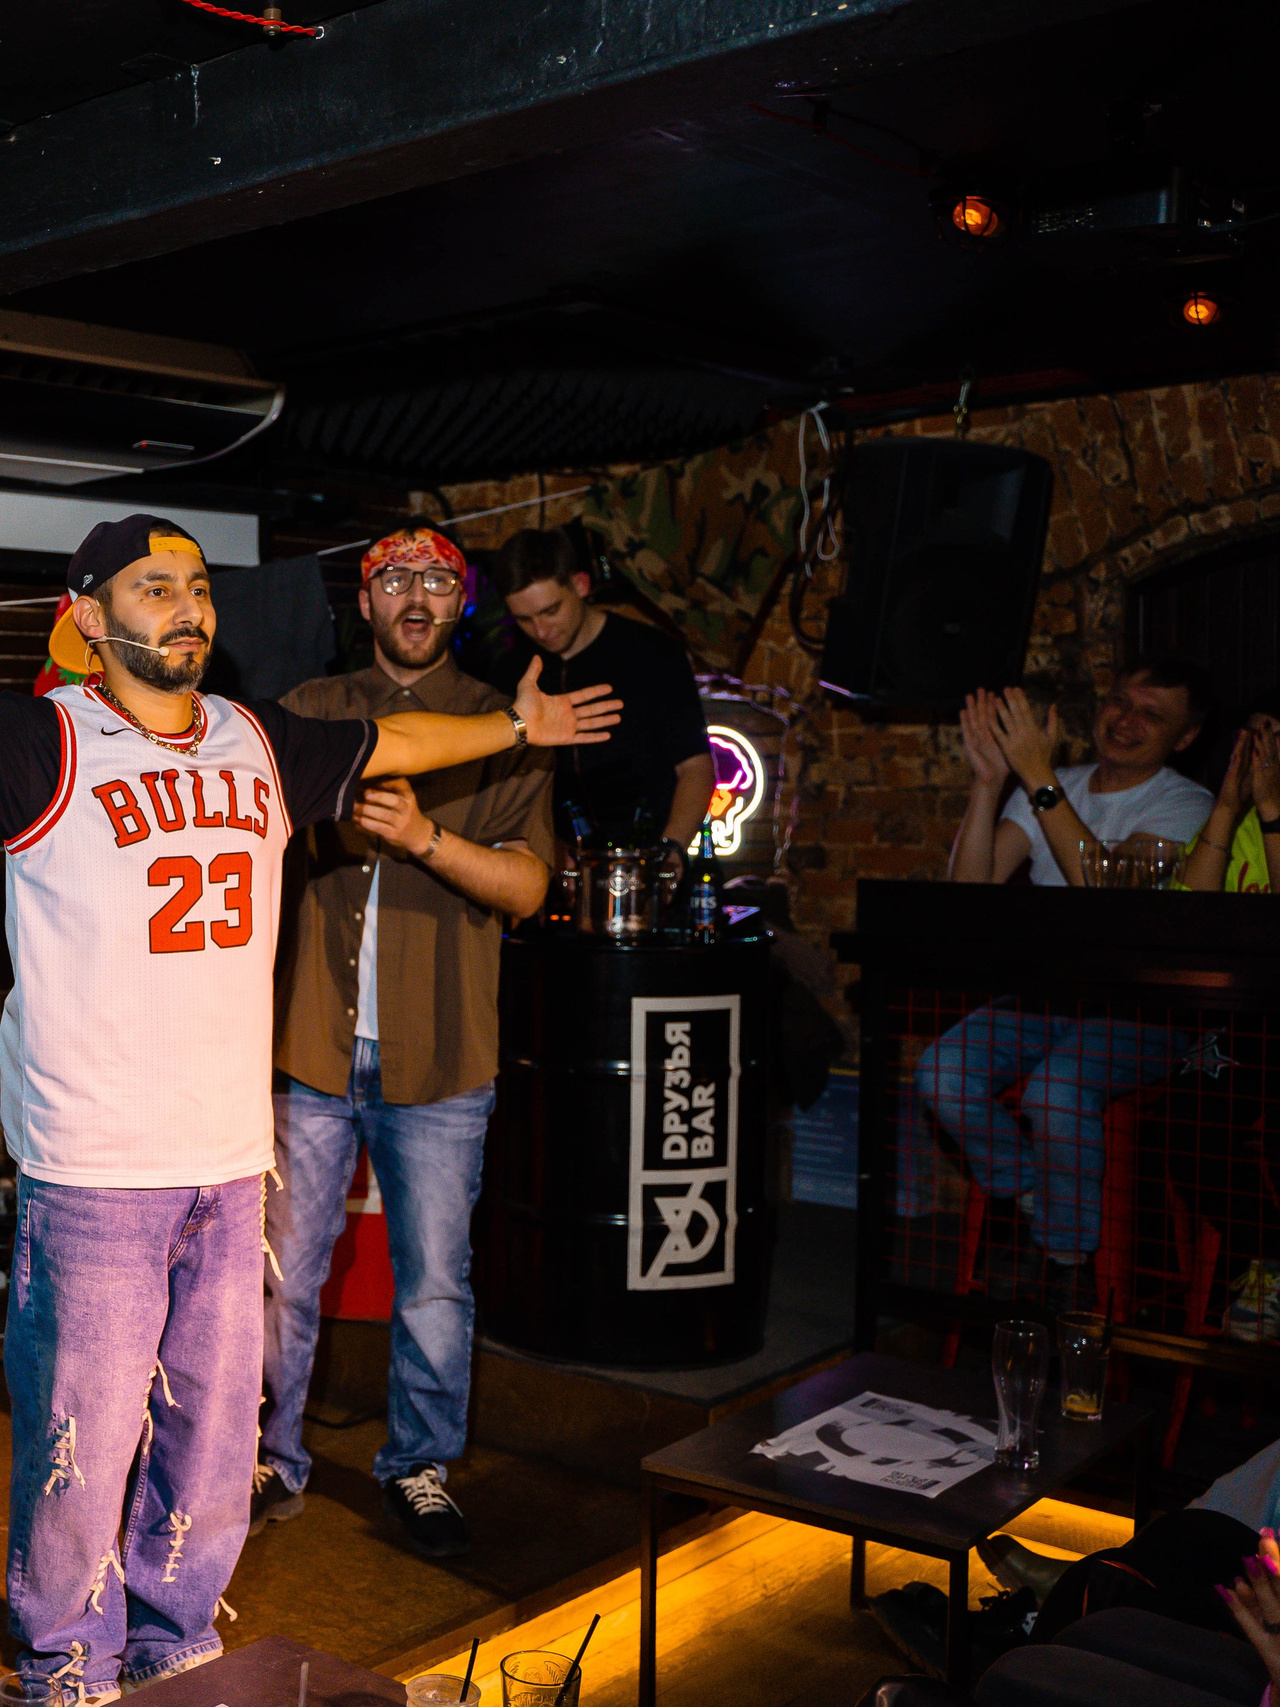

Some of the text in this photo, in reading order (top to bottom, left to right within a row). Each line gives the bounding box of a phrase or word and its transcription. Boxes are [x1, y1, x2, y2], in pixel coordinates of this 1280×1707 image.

[91, 768, 270, 849] BULLS
[147, 851, 253, 954] 23
[690, 1081, 716, 1159] BAR
